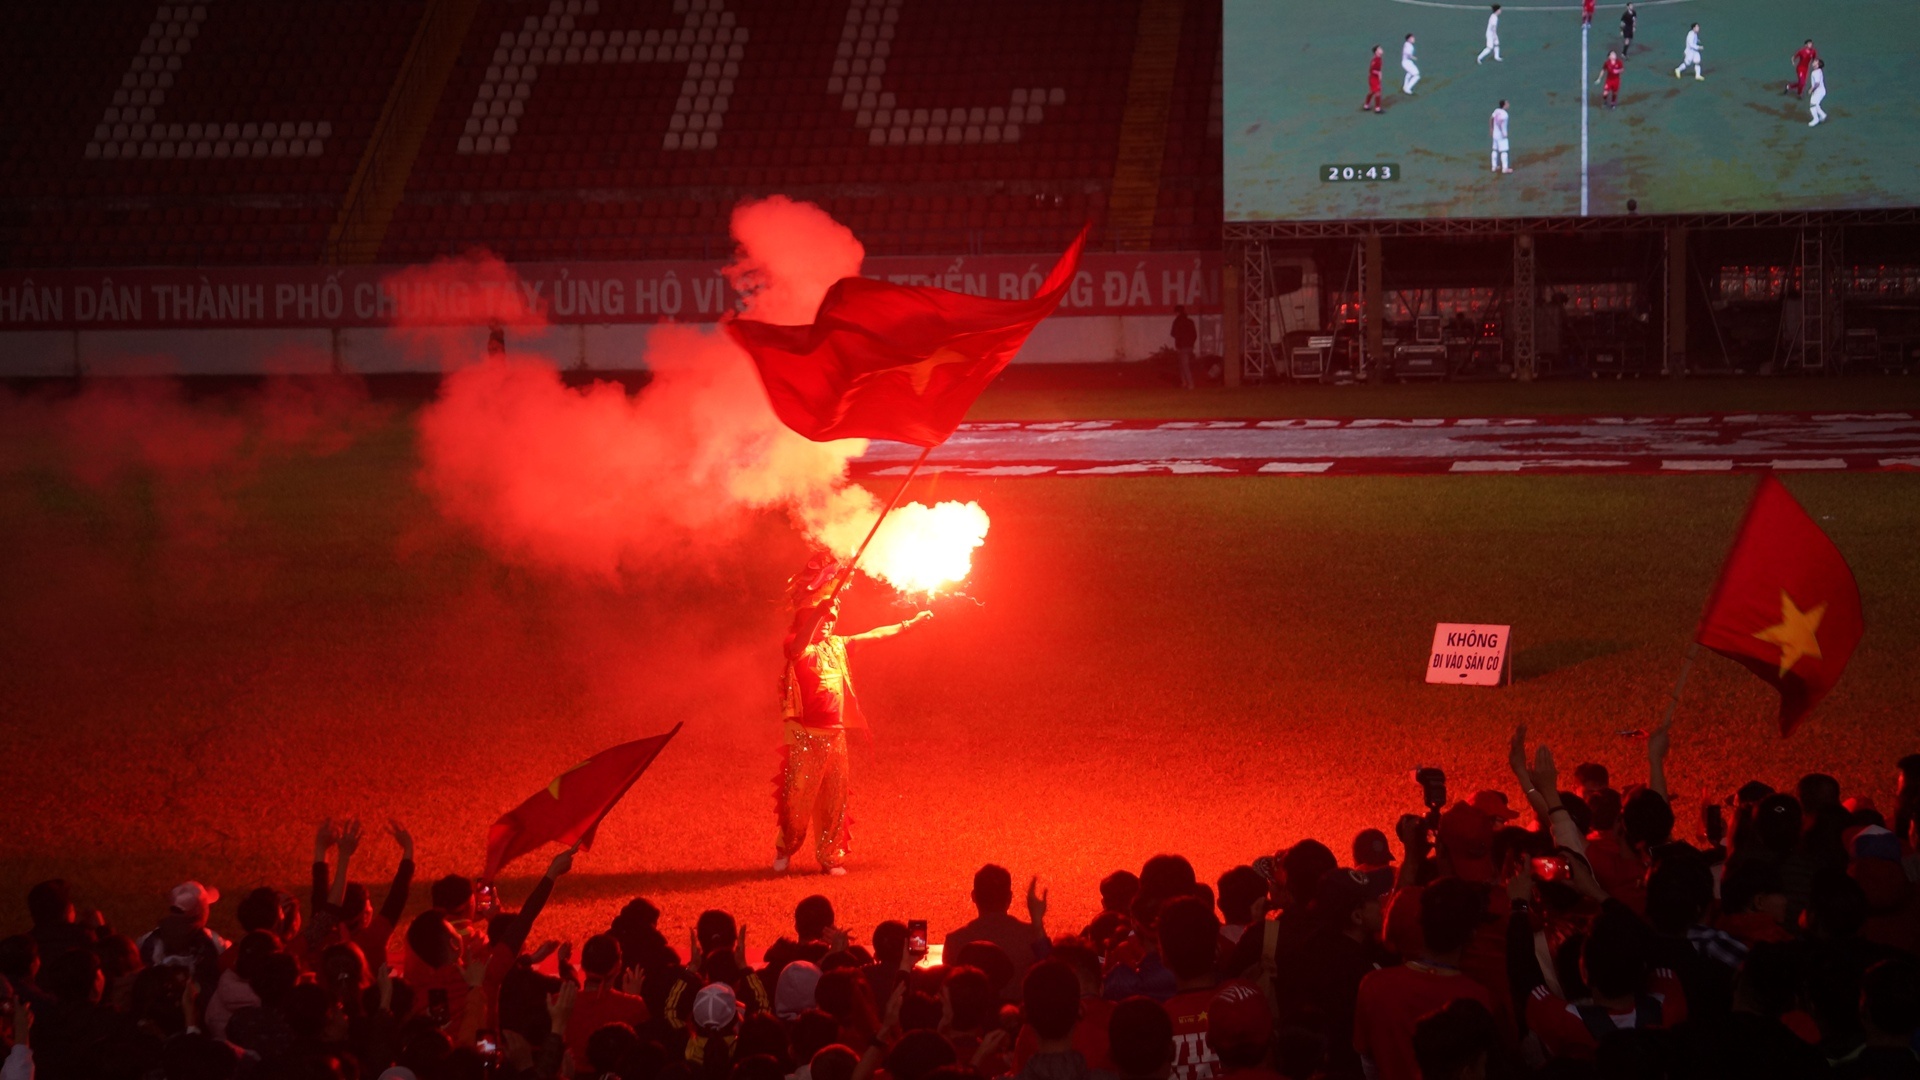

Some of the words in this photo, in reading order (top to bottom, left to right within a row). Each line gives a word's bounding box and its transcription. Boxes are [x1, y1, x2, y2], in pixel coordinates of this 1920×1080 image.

[1328, 166, 1391, 181] 20:43
[74, 276, 142, 322] DÂN
[152, 275, 264, 321] THÀNH
[275, 270, 344, 319] PHỐ
[354, 281, 470, 319] CHUNG
[478, 280, 544, 316] TAY
[553, 268, 625, 316] ỦNG
[636, 270, 683, 321] HỘ
[692, 266, 724, 313] VÌ
[998, 263, 1093, 308] BÓG
[1101, 261, 1152, 307] ĐÁ
[1162, 257, 1219, 307] HẢI
[1446, 629, 1498, 648] KHÔNG
[1432, 653, 1444, 668] ĐI
[1445, 651, 1464, 669] VÀO
[1465, 652, 1485, 670] SÂN
[1486, 650, 1499, 671] CỎ
